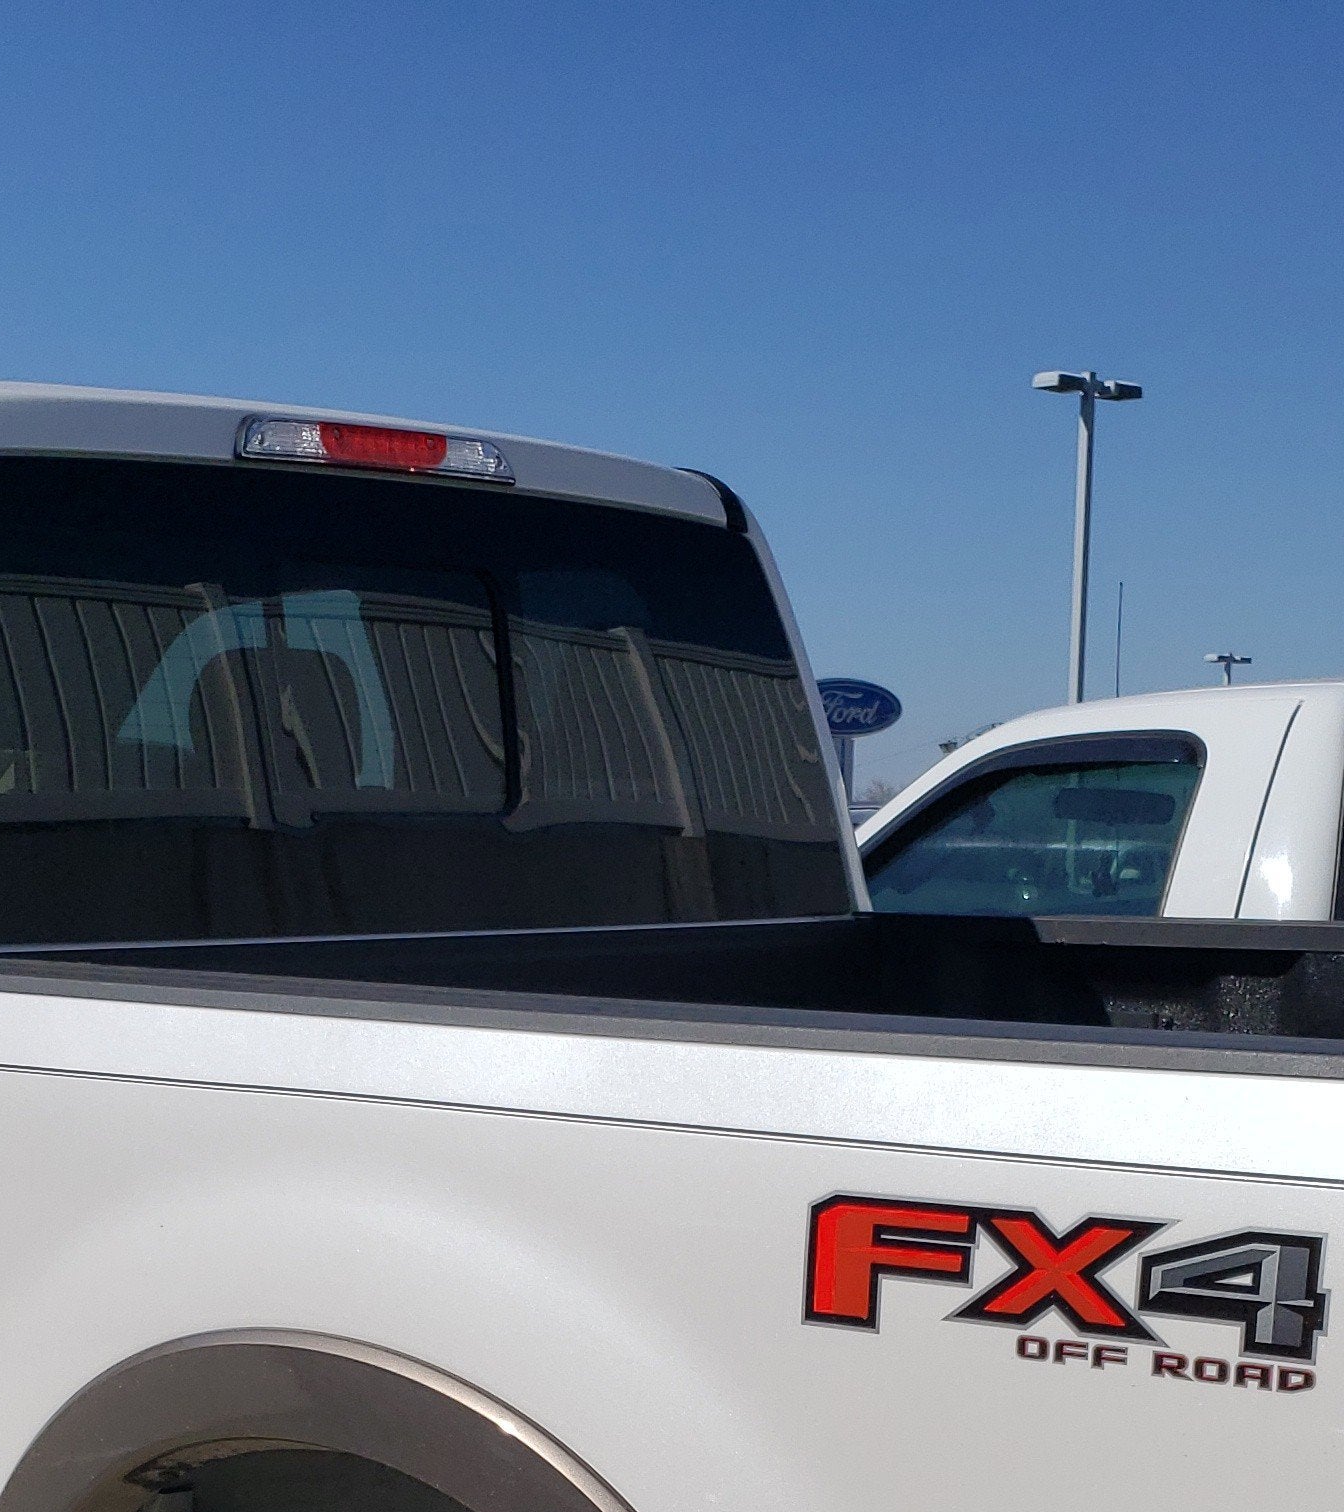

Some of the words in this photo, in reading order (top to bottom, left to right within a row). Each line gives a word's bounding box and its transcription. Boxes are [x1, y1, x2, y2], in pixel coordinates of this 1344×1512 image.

[821, 689, 881, 724] Ford
[800, 1189, 1332, 1366] FX4
[1015, 1334, 1129, 1371] OFF
[1150, 1351, 1317, 1394] ROAD
